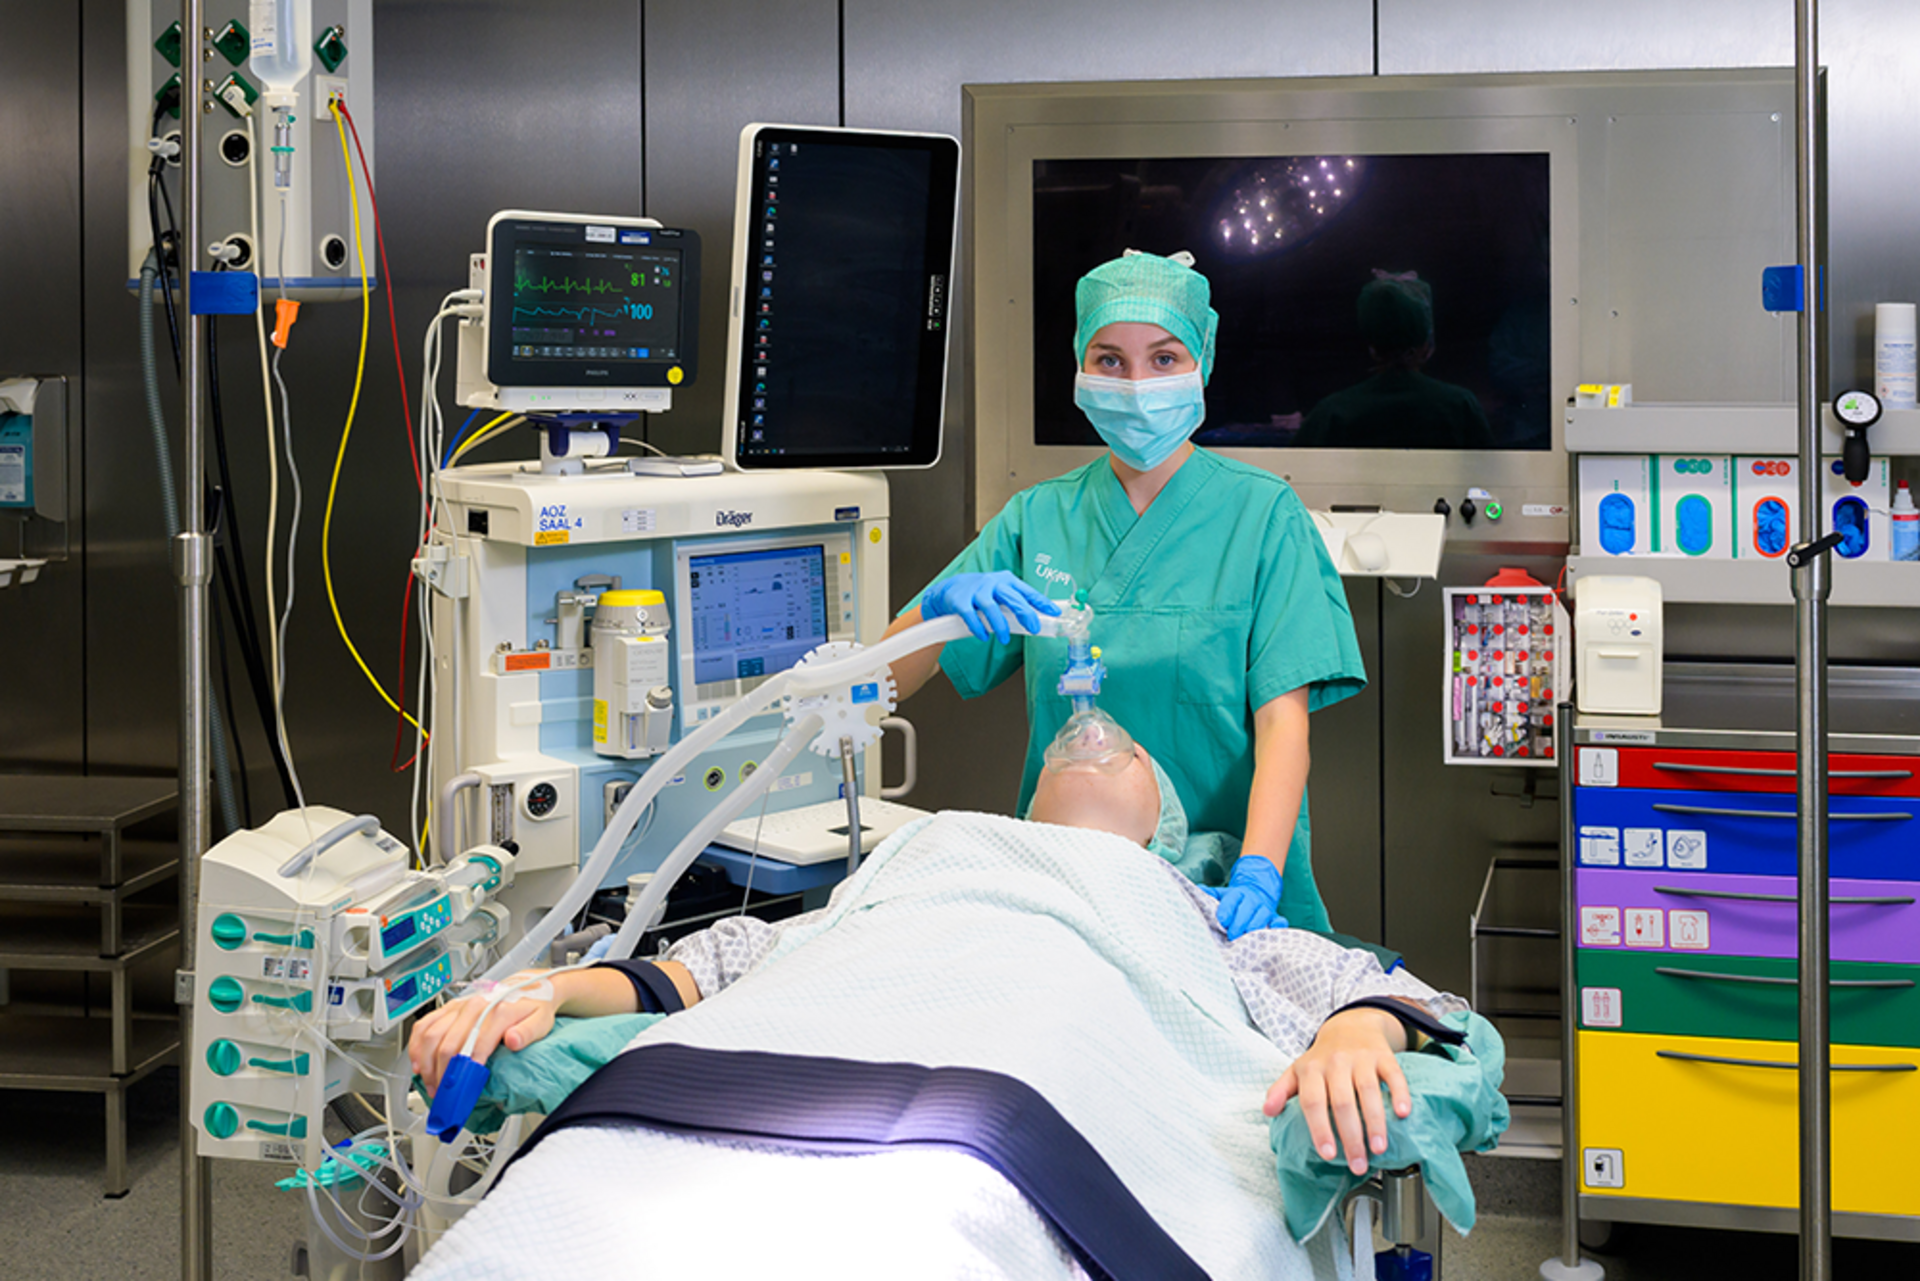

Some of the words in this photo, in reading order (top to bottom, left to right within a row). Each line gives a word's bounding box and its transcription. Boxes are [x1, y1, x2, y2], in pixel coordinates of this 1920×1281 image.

[630, 272, 646, 287] 81
[631, 303, 653, 320] 100
[539, 504, 567, 518] AOZ
[539, 517, 572, 531] SAAL
[574, 517, 583, 528] 4
[716, 510, 753, 528] Dräger
